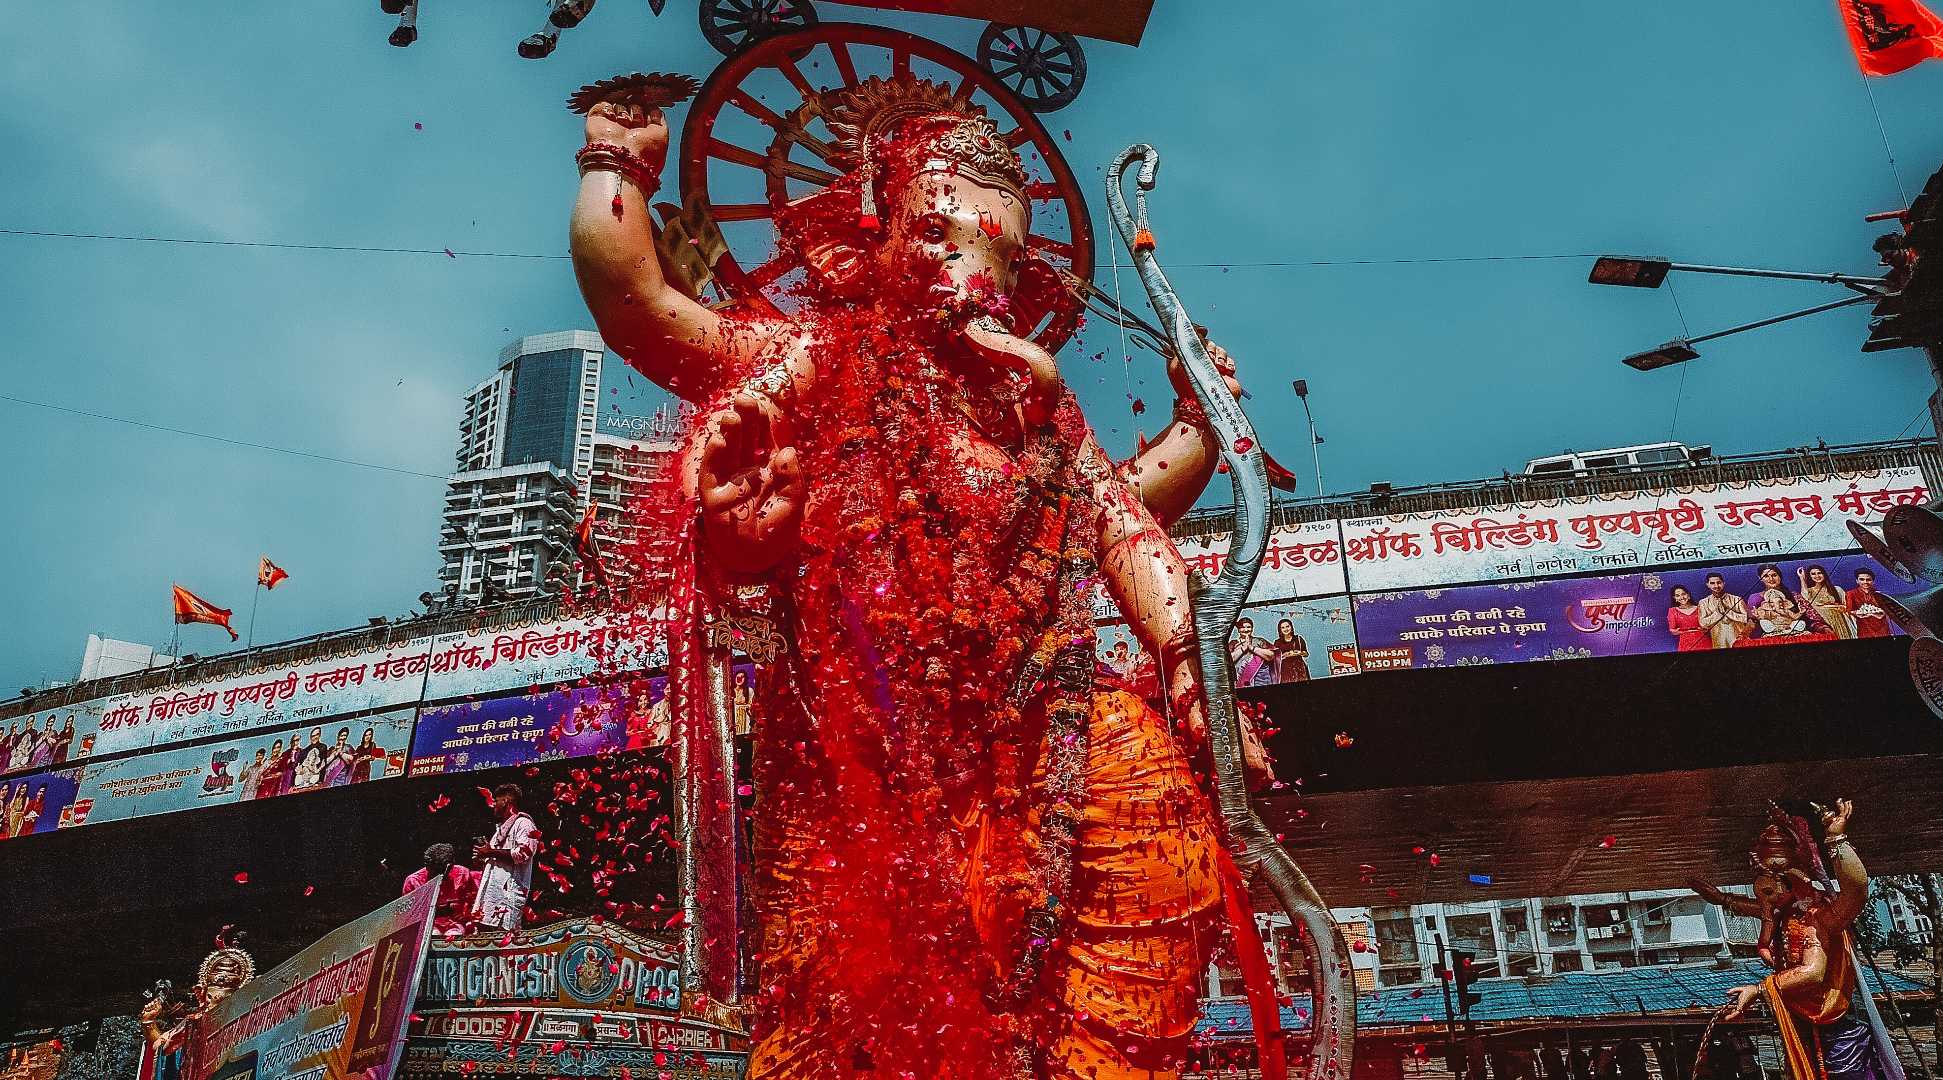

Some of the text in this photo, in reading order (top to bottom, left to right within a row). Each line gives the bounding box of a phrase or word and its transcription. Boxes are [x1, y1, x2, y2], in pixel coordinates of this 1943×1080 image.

[606, 417, 680, 433] MAGNUM
[1347, 527, 1421, 561] श्रॉफ
[1430, 514, 1558, 554] बिल्डिंग
[1714, 495, 1823, 526] उत्सव
[1496, 559, 1522, 575] सर्व
[1536, 557, 1577, 572] गणेश
[1654, 542, 1704, 561] हार्दिक
[1717, 540, 1772, 555] स्वागत
[1451, 610, 1471, 623] की
[1506, 606, 1526, 619] रहे
[1400, 622, 1547, 641] आपके परिवार पे कृपा
[431, 643, 484, 673] श्रॉफ
[492, 627, 579, 665] बिल्डिंग
[1364, 648, 1410, 659] MON-SAT
[1333, 666, 1357, 675] SAB
[1364, 657, 1412, 669] 9:30 PM
[100, 699, 142, 731] श्रॉफ
[147, 688, 217, 724] बिल्डिंग
[305, 664, 367, 694] उत्सव
[373, 653, 426, 681] मंडळ
[413, 755, 446, 766] MON-SAT
[412, 764, 445, 776] 9:30 PM
[442, 1017, 507, 1035] GOODS
[657, 1023, 713, 1048] CARRIER
